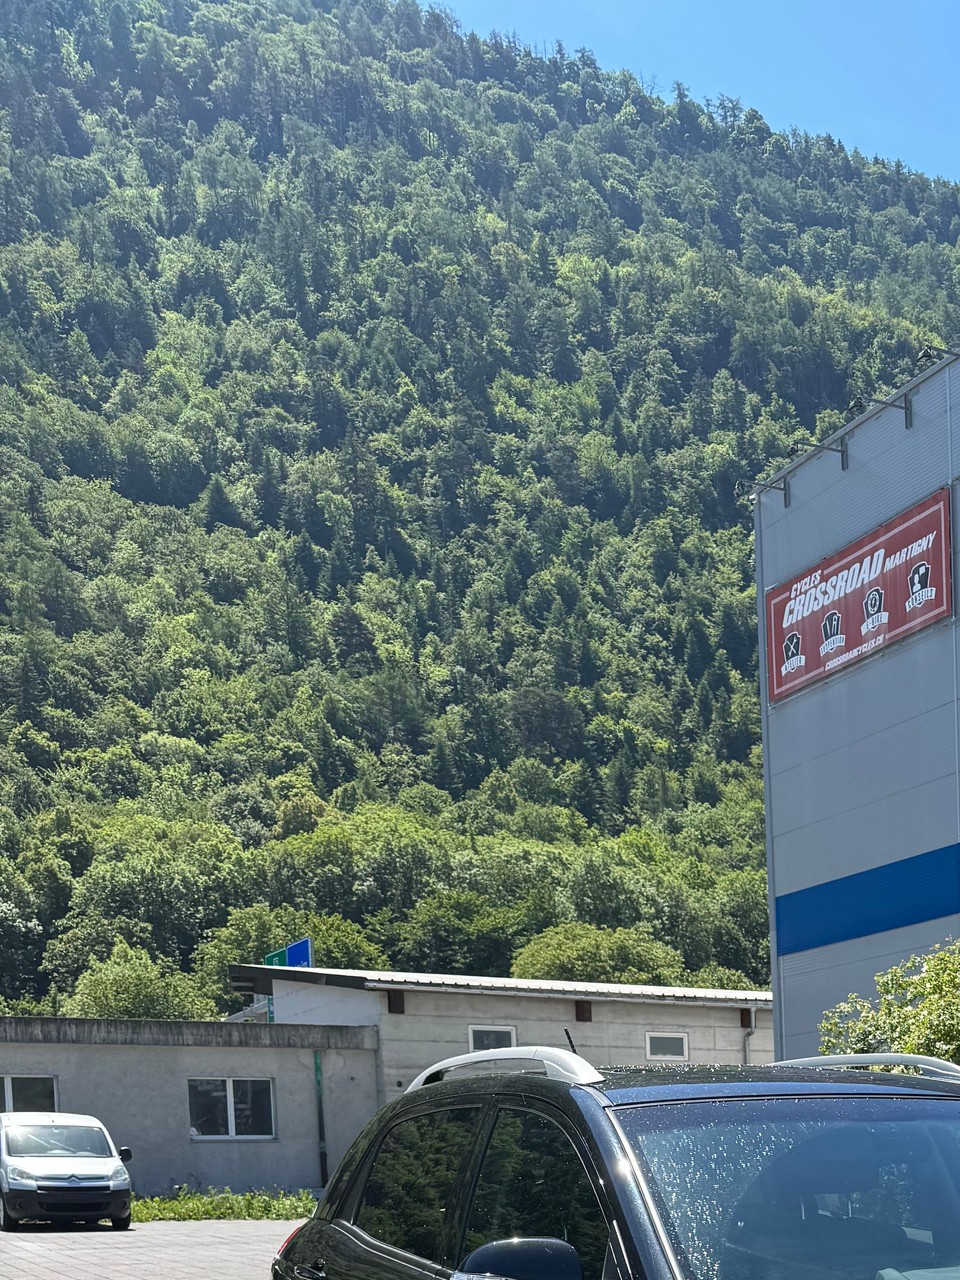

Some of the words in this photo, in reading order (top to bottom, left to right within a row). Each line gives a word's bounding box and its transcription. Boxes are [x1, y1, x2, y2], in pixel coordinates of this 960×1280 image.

[782, 548, 885, 628] CROSSROAD
[883, 531, 937, 573] MARTIGNY
[790, 569, 822, 598] CYCLES
[907, 588, 933, 609] CONSEILS
[866, 613, 883, 629] E-BIKE
[784, 657, 802, 671] ATELIER
